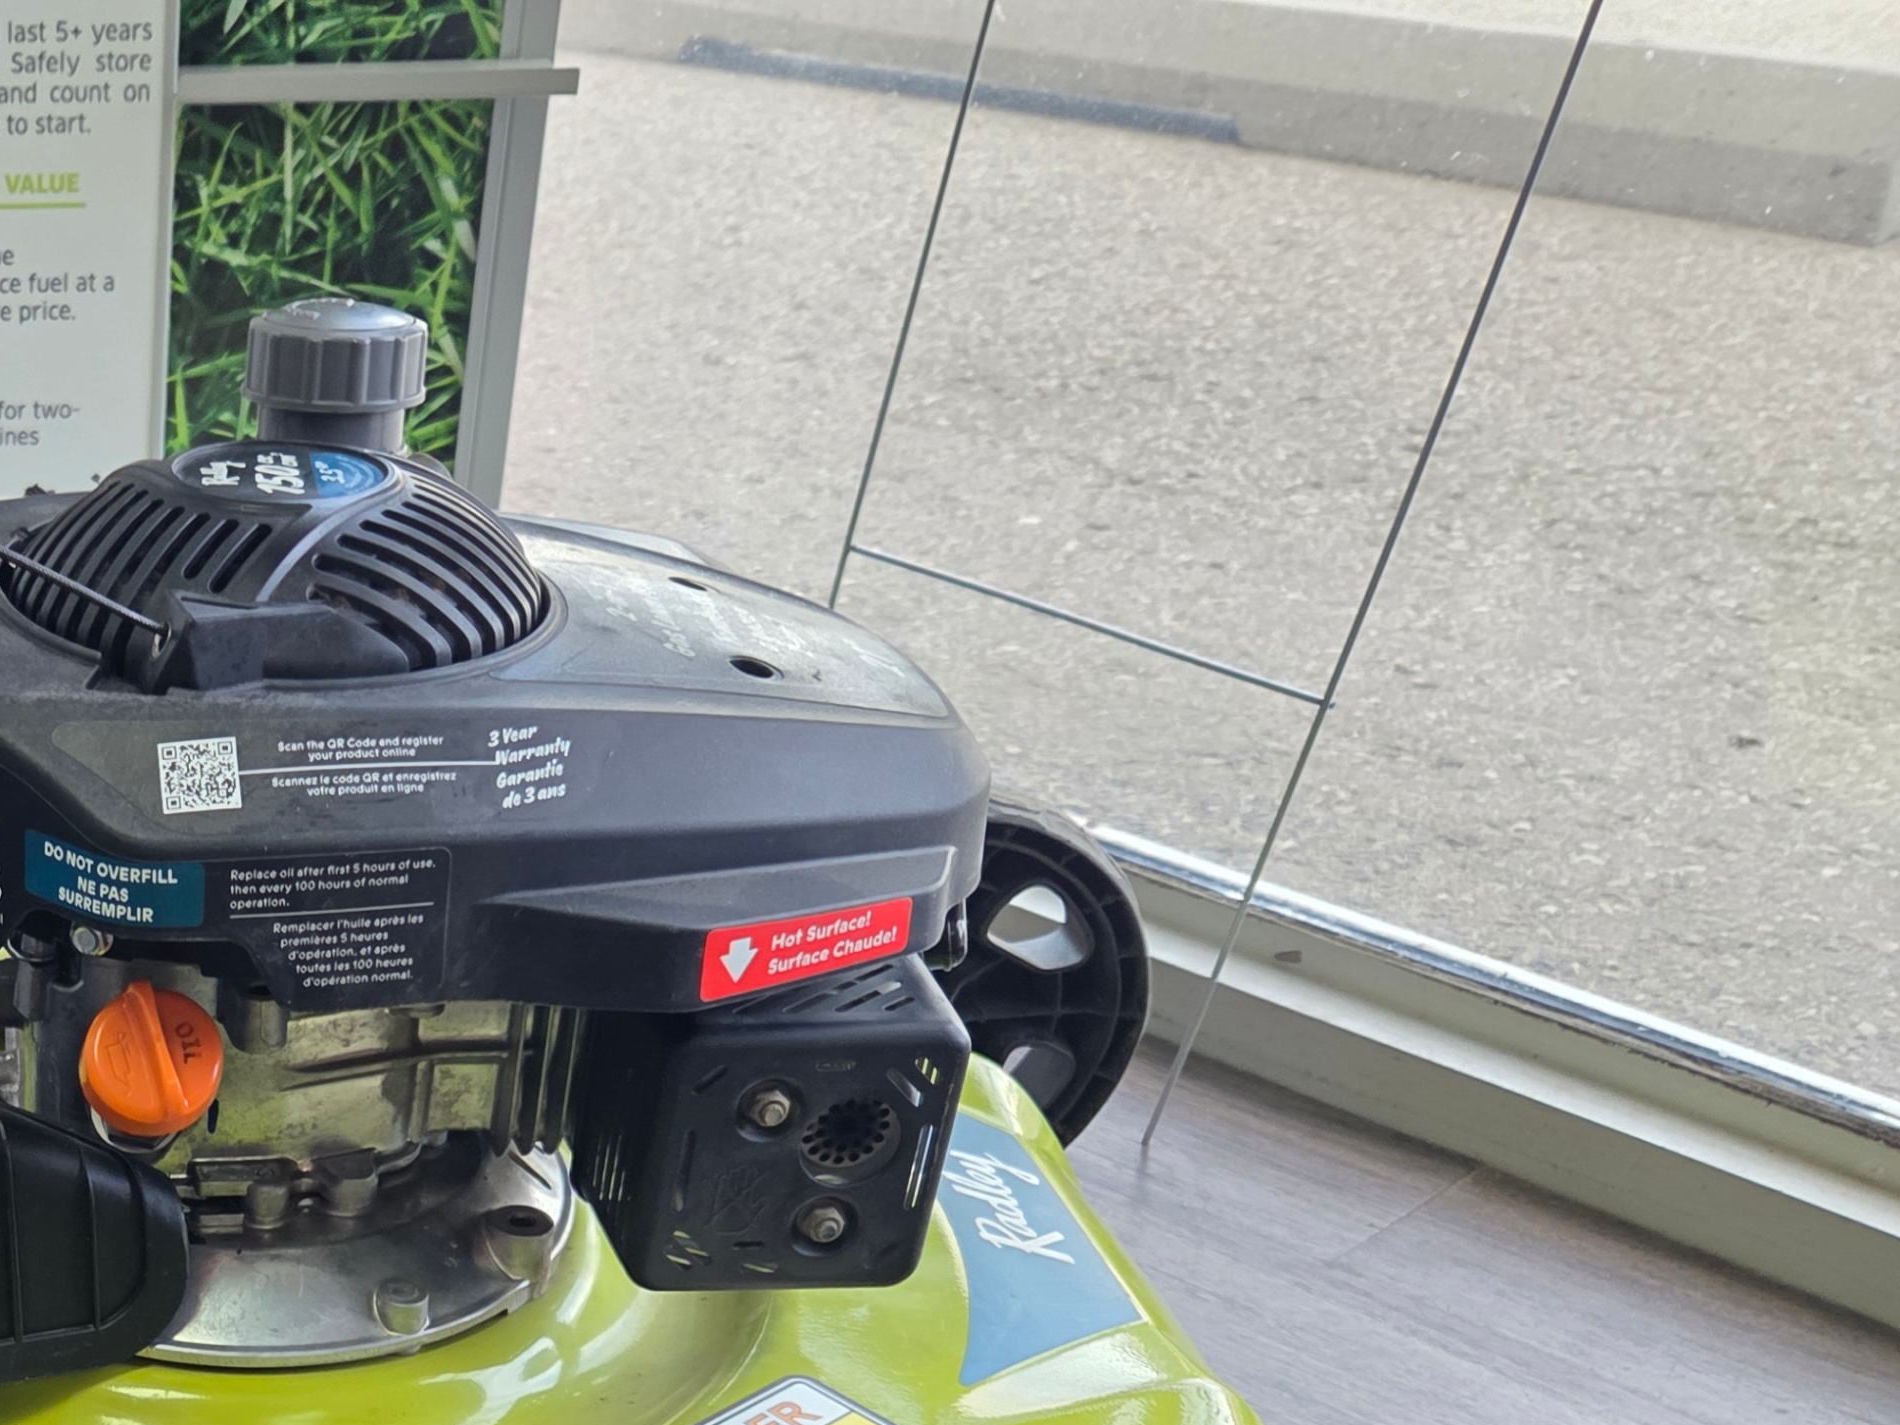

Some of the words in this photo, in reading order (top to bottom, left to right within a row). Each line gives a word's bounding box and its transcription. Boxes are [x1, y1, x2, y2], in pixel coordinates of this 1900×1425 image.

[8, 21, 46, 43] last
[56, 21, 82, 42] 5+
[92, 21, 153, 46] years
[11, 51, 80, 77] Safely
[96, 52, 152, 73] store
[50, 82, 111, 103] count
[123, 84, 150, 102] on
[6, 114, 28, 135] to
[35, 113, 91, 134] start.
[4, 173, 79, 193] VALUE
[29, 273, 69, 294] fuel
[76, 274, 96, 293] at
[103, 277, 115, 292] a
[19, 302, 76, 324] price.
[33, 402, 80, 419] two-
[278, 741, 303, 752] Scan
[307, 740, 324, 749] the
[327, 738, 344, 749] QR
[347, 738, 376, 748] Code
[379, 737, 399, 747] and
[402, 736, 444, 747] register
[488, 731, 500, 747] 3
[502, 726, 538, 742] Year
[308, 751, 333, 762] your
[336, 749, 379, 761] product
[382, 748, 416, 757] online
[495, 736, 571, 765] Warranty
[272, 776, 317, 788] Scannez
[320, 775, 329, 784] le
[333, 773, 360, 784] code
[363, 772, 379, 783] QR
[382, 773, 394, 782] et
[396, 772, 456, 783] enregistrez
[496, 760, 563, 789] Garantie
[307, 786, 335, 796] votre
[338, 783, 378, 796] produit
[381, 784, 394, 793] en
[397, 783, 424, 794] ligne
[502, 790, 520, 809] de
[523, 787, 535, 803] 3
[537, 784, 566, 800] ans
[44, 841, 64, 861] DO
[66, 850, 94, 873] NOT
[97, 862, 178, 884] OVERFILL
[230, 869, 277, 882] Replace
[279, 868, 294, 878] oil
[297, 866, 324, 877] after
[327, 864, 351, 875] first
[353, 863, 360, 873] 5
[363, 861, 396, 872] hours
[398, 860, 410, 870] of
[78, 875, 96, 895] NE
[100, 883, 128, 903] PAS
[230, 885, 256, 895] then
[259, 883, 292, 894] every
[295, 880, 316, 891] 100
[318, 878, 351, 890] hours
[353, 877, 366, 887] of
[368, 875, 409, 886] normal
[58, 886, 154, 923] SURREMPLIR
[230, 898, 290, 910] operation.
[273, 921, 335, 934] Remplacer
[337, 917, 371, 929] l'huile
[374, 915, 405, 928] après
[408, 914, 424, 923] les
[771, 929, 803, 951] Hot
[806, 910, 872, 942] Surface!
[280, 933, 338, 948] premières
[340, 933, 348, 943] 5
[350, 931, 389, 942] heures
[359, 945, 372, 955] et
[374, 944, 406, 956] après
[768, 949, 828, 975] Surface
[833, 926, 897, 958] Chaude!
[296, 963, 332, 974] toutes
[334, 961, 350, 971] les
[353, 959, 373, 969] 100
[375, 957, 413, 968] heures
[303, 972, 369, 988] d'opération
[371, 970, 413, 982] normal.
[175, 1022, 201, 1065] OIL
[943, 1150, 1075, 1264] Radley
